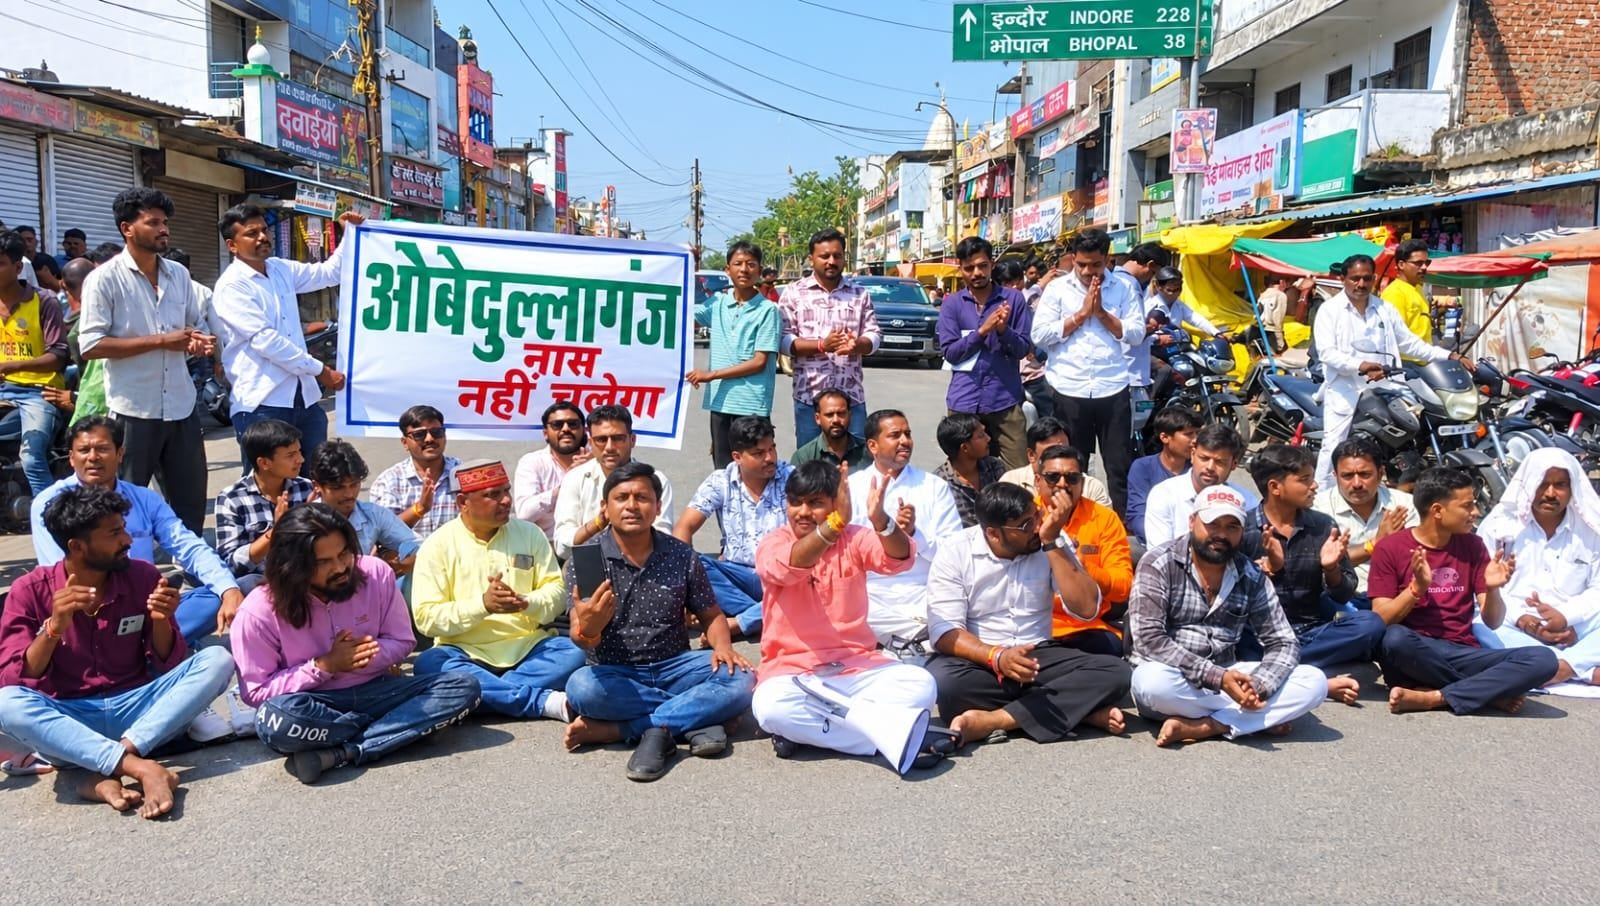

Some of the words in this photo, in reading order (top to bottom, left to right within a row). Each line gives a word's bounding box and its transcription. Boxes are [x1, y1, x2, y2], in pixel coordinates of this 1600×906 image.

[991, 5, 1049, 30] इन्दौर
[1070, 10, 1133, 25] INDORE
[1156, 7, 1190, 23] 228
[990, 34, 1050, 54] भोपाल
[1069, 36, 1137, 51] BHOPAL
[1163, 34, 1185, 48] 38
[362, 241, 682, 363] ओबेदुल्लागंज
[458, 369, 537, 420] नहीं
[550, 373, 666, 419] चलेगा
[287, 723, 329, 741] DIOR
